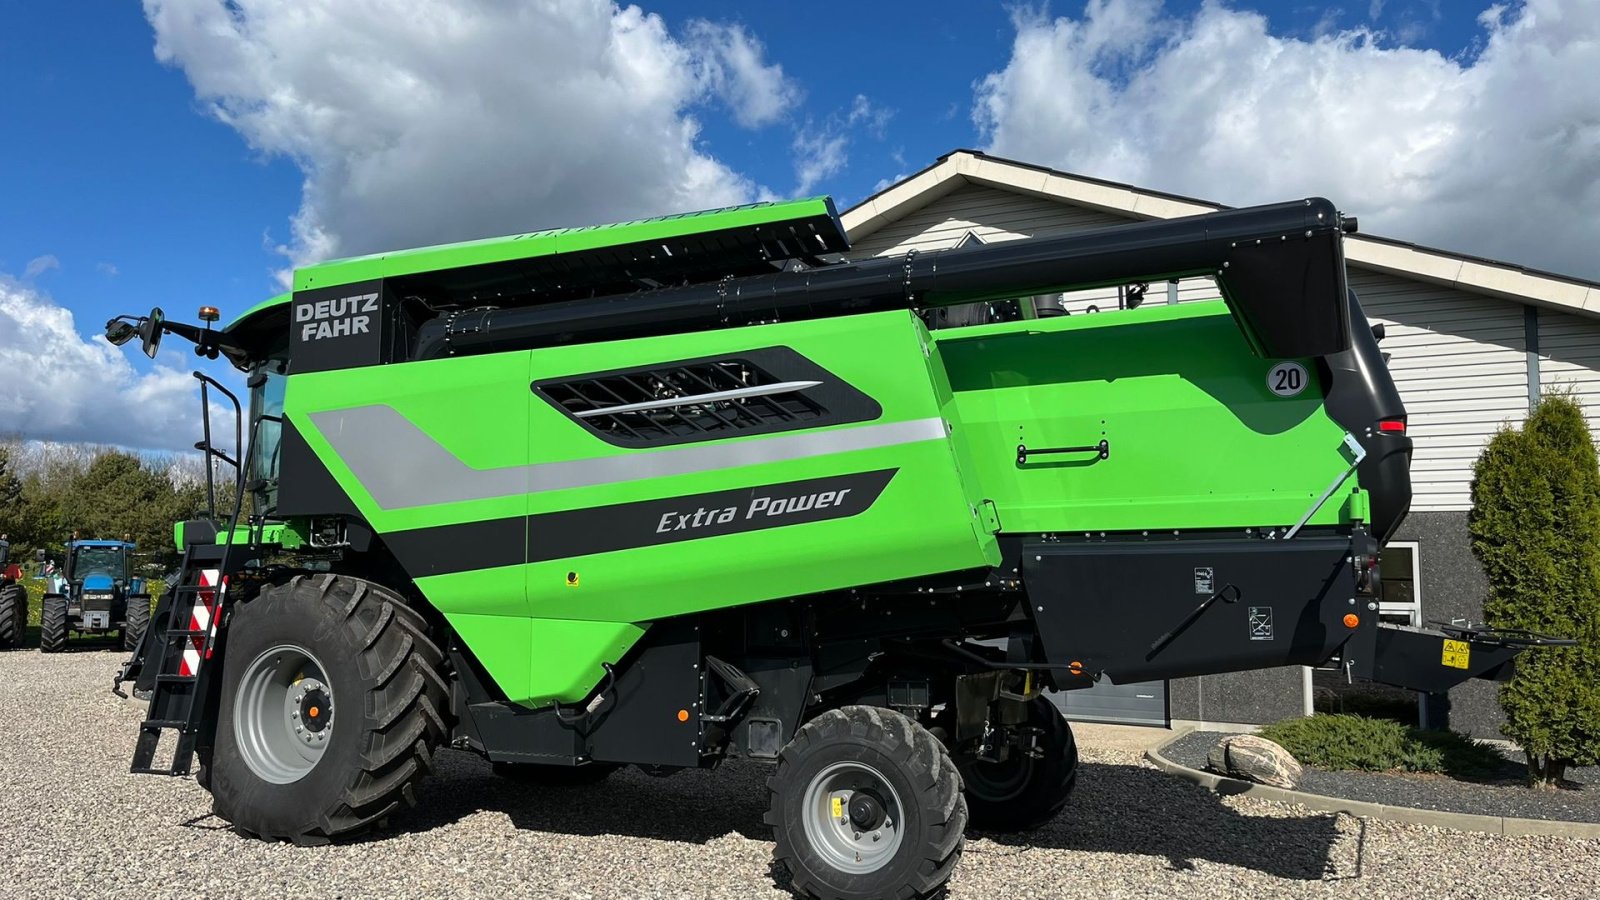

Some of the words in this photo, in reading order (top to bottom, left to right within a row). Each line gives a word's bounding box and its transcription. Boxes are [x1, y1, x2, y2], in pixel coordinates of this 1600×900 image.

[296, 293, 379, 322] DEUTZ
[302, 315, 370, 342] FAHR
[1275, 368, 1300, 390] 20
[656, 506, 737, 534] Extra
[746, 488, 851, 519] Power
